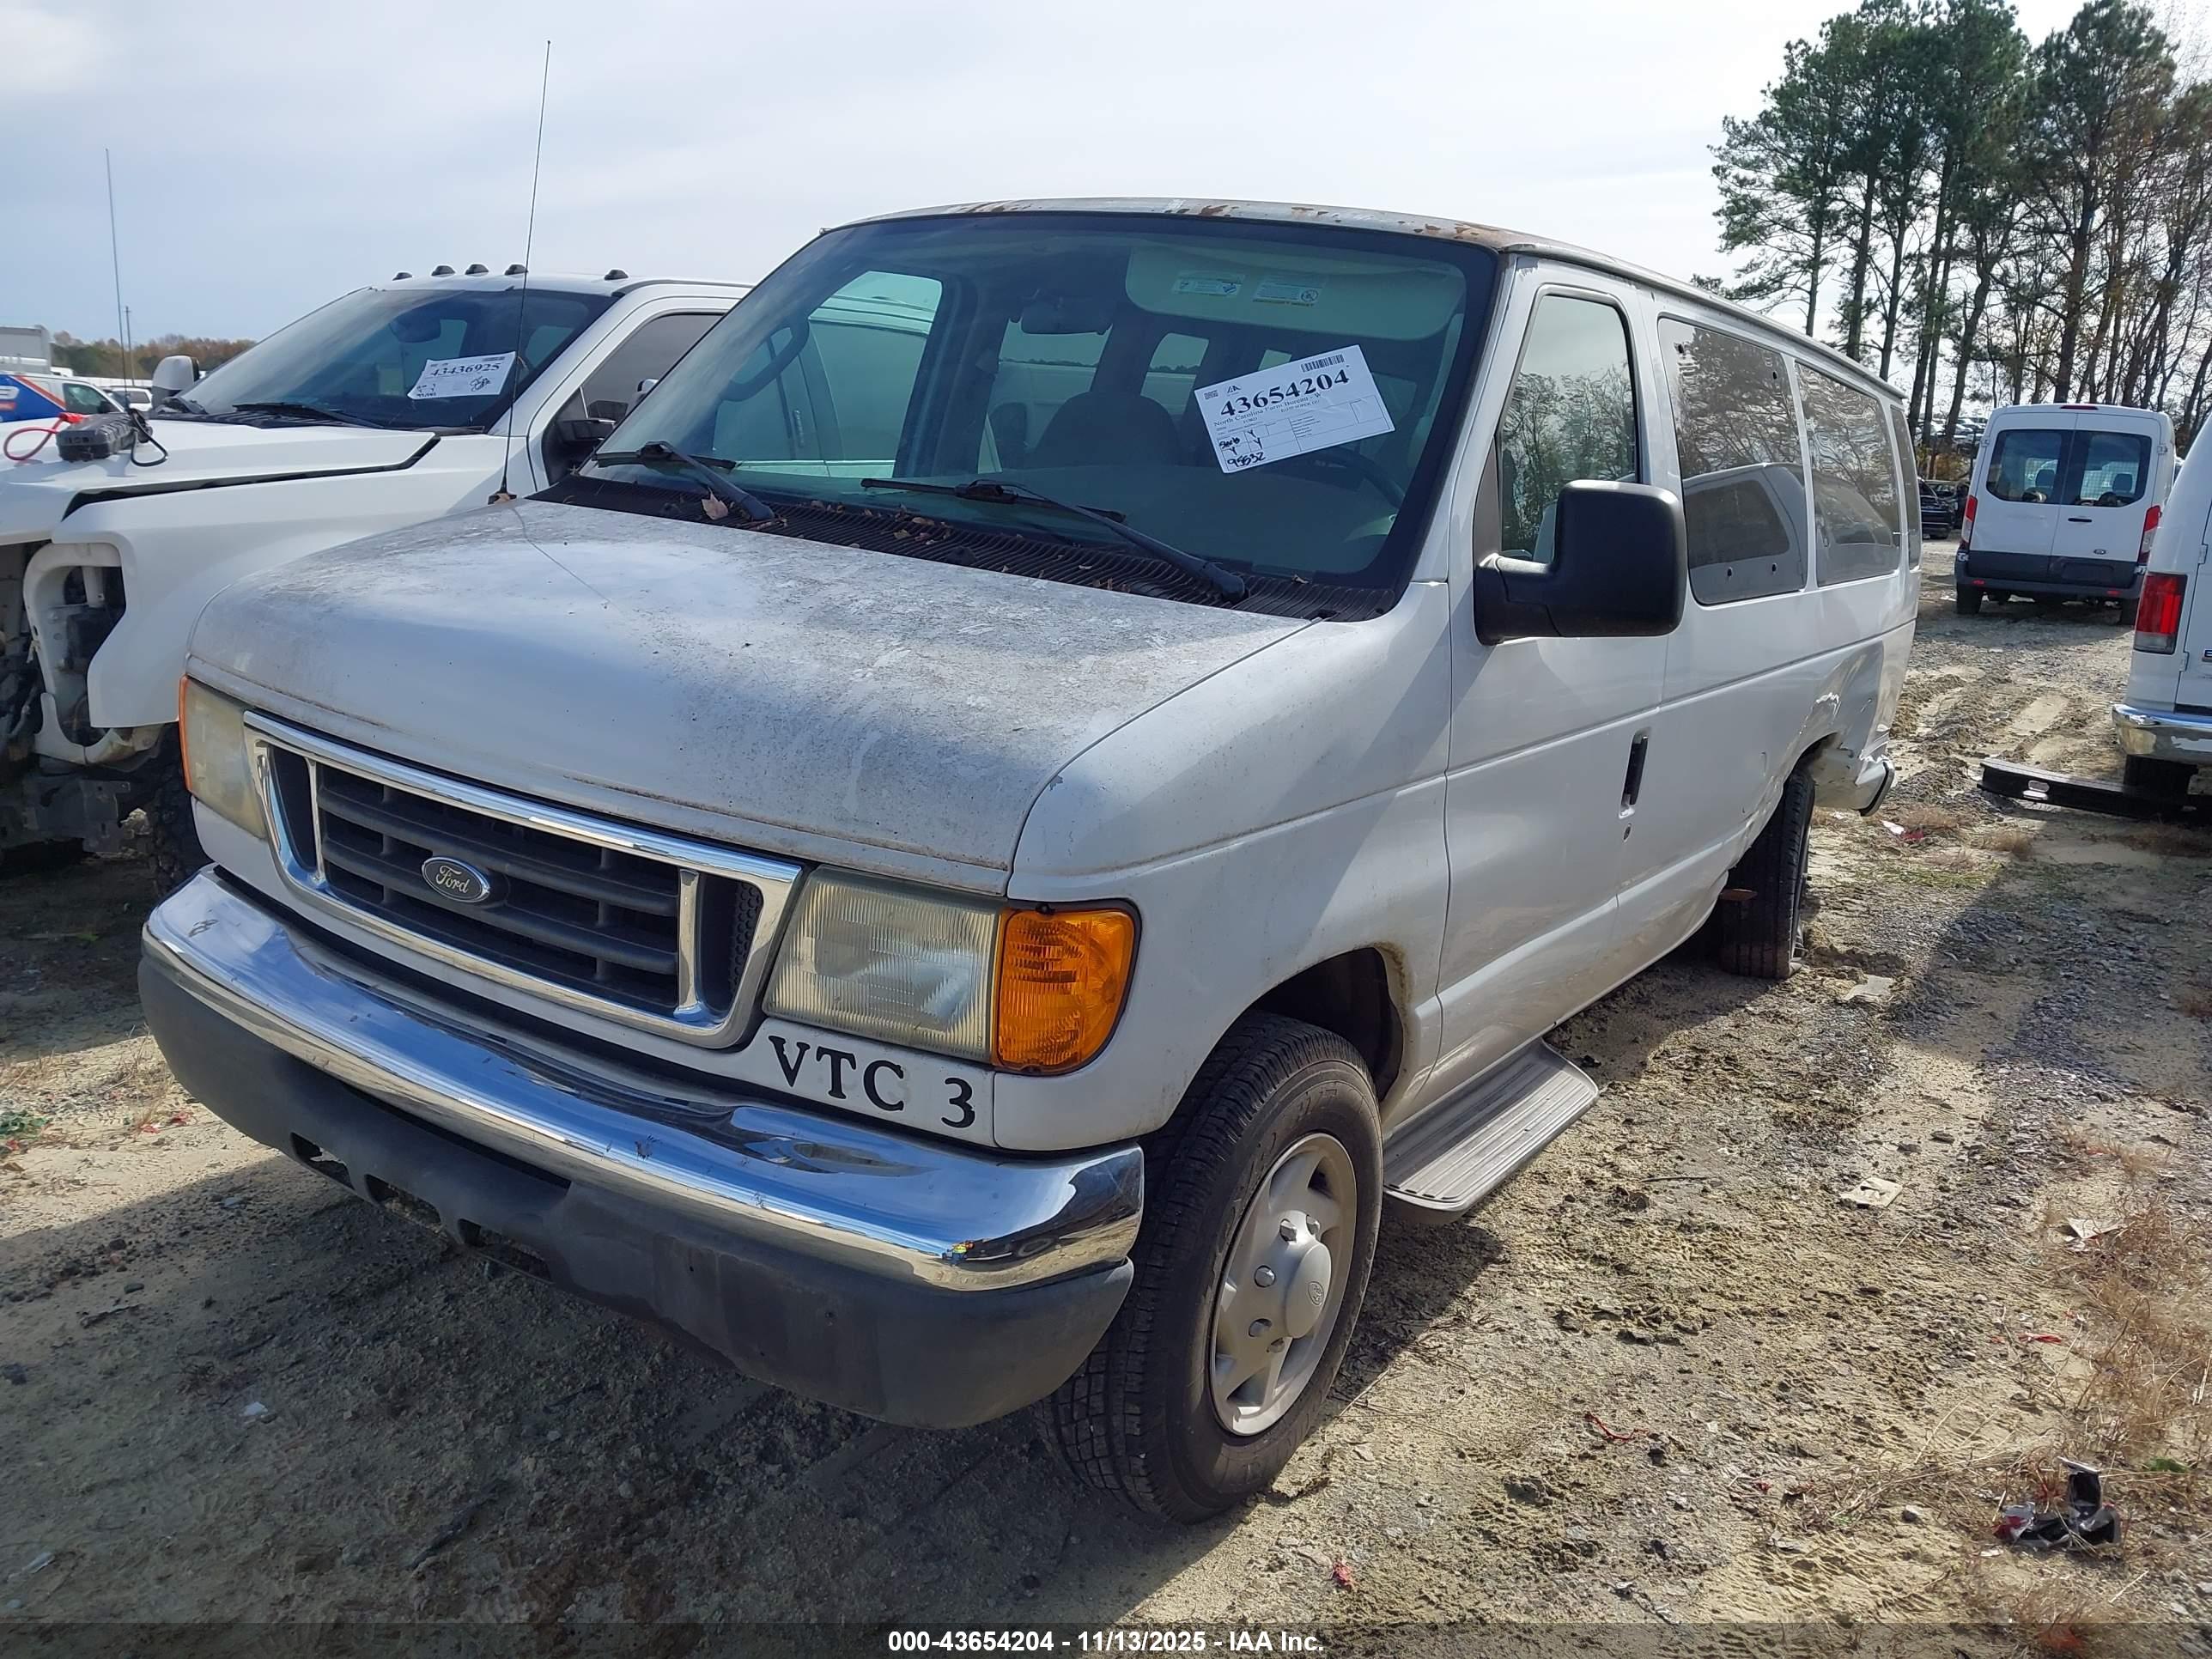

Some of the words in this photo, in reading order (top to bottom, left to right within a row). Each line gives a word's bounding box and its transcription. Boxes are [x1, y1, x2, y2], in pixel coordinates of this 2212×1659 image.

[1220, 369, 1350, 417] 43654204
[1213, 417, 1234, 427] North
[1235, 409, 1264, 421] Carolina
[435, 865, 471, 894] Ford
[768, 1035, 904, 1112] VTC
[941, 1077, 975, 1128] 3
